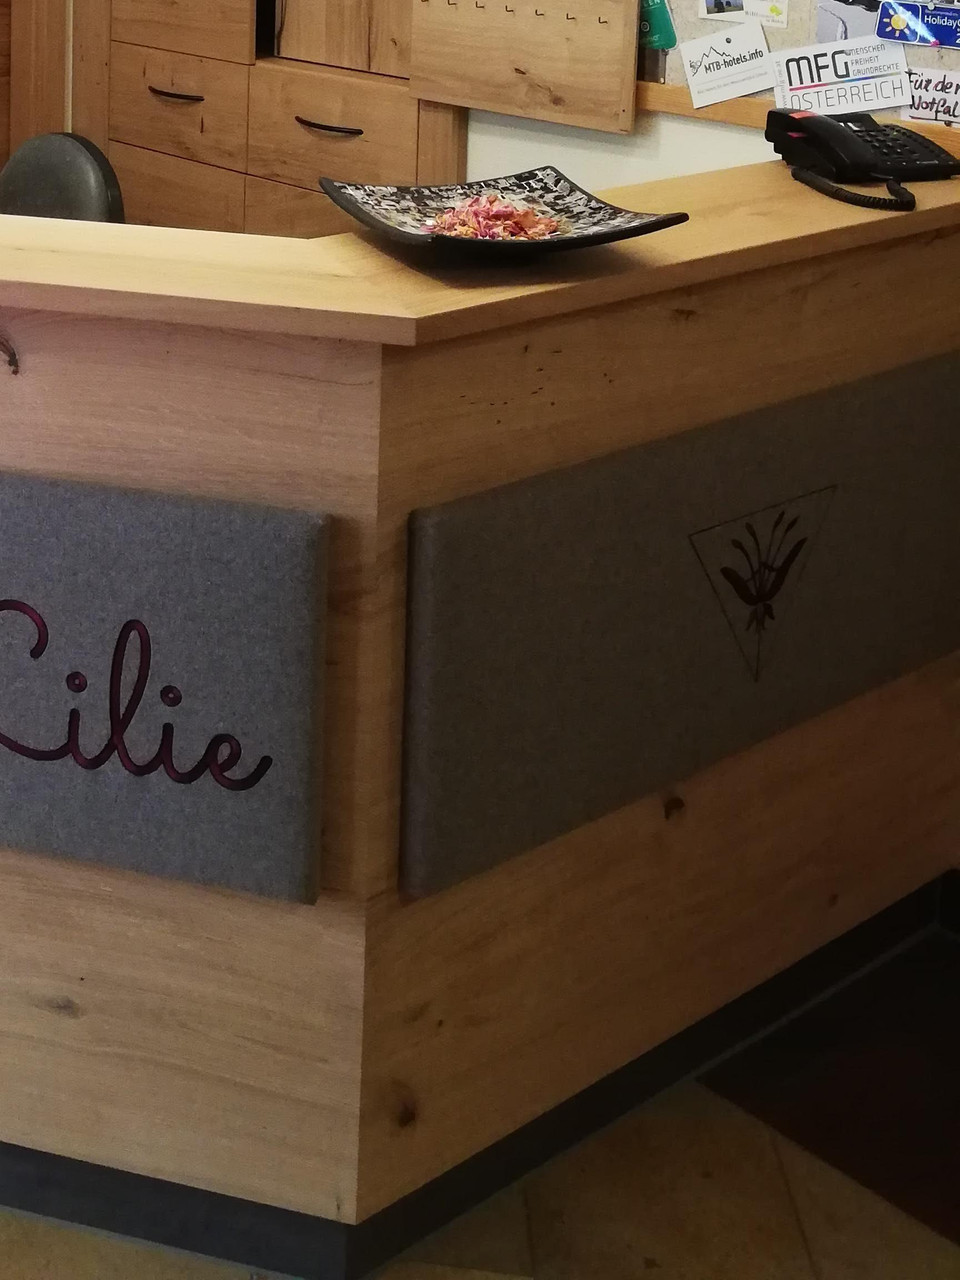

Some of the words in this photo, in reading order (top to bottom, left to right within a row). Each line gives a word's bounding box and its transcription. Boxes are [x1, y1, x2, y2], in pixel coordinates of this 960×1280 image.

[924, 15, 960, 29] Holiday
[850, 43, 886, 56] MENSCHEN
[704, 48, 764, 74] MTB-hotels.info
[850, 55, 879, 66] FREIHEIT
[785, 49, 850, 87] MFG
[852, 63, 900, 77] GRUNDRECHTE
[904, 68, 932, 92] Für
